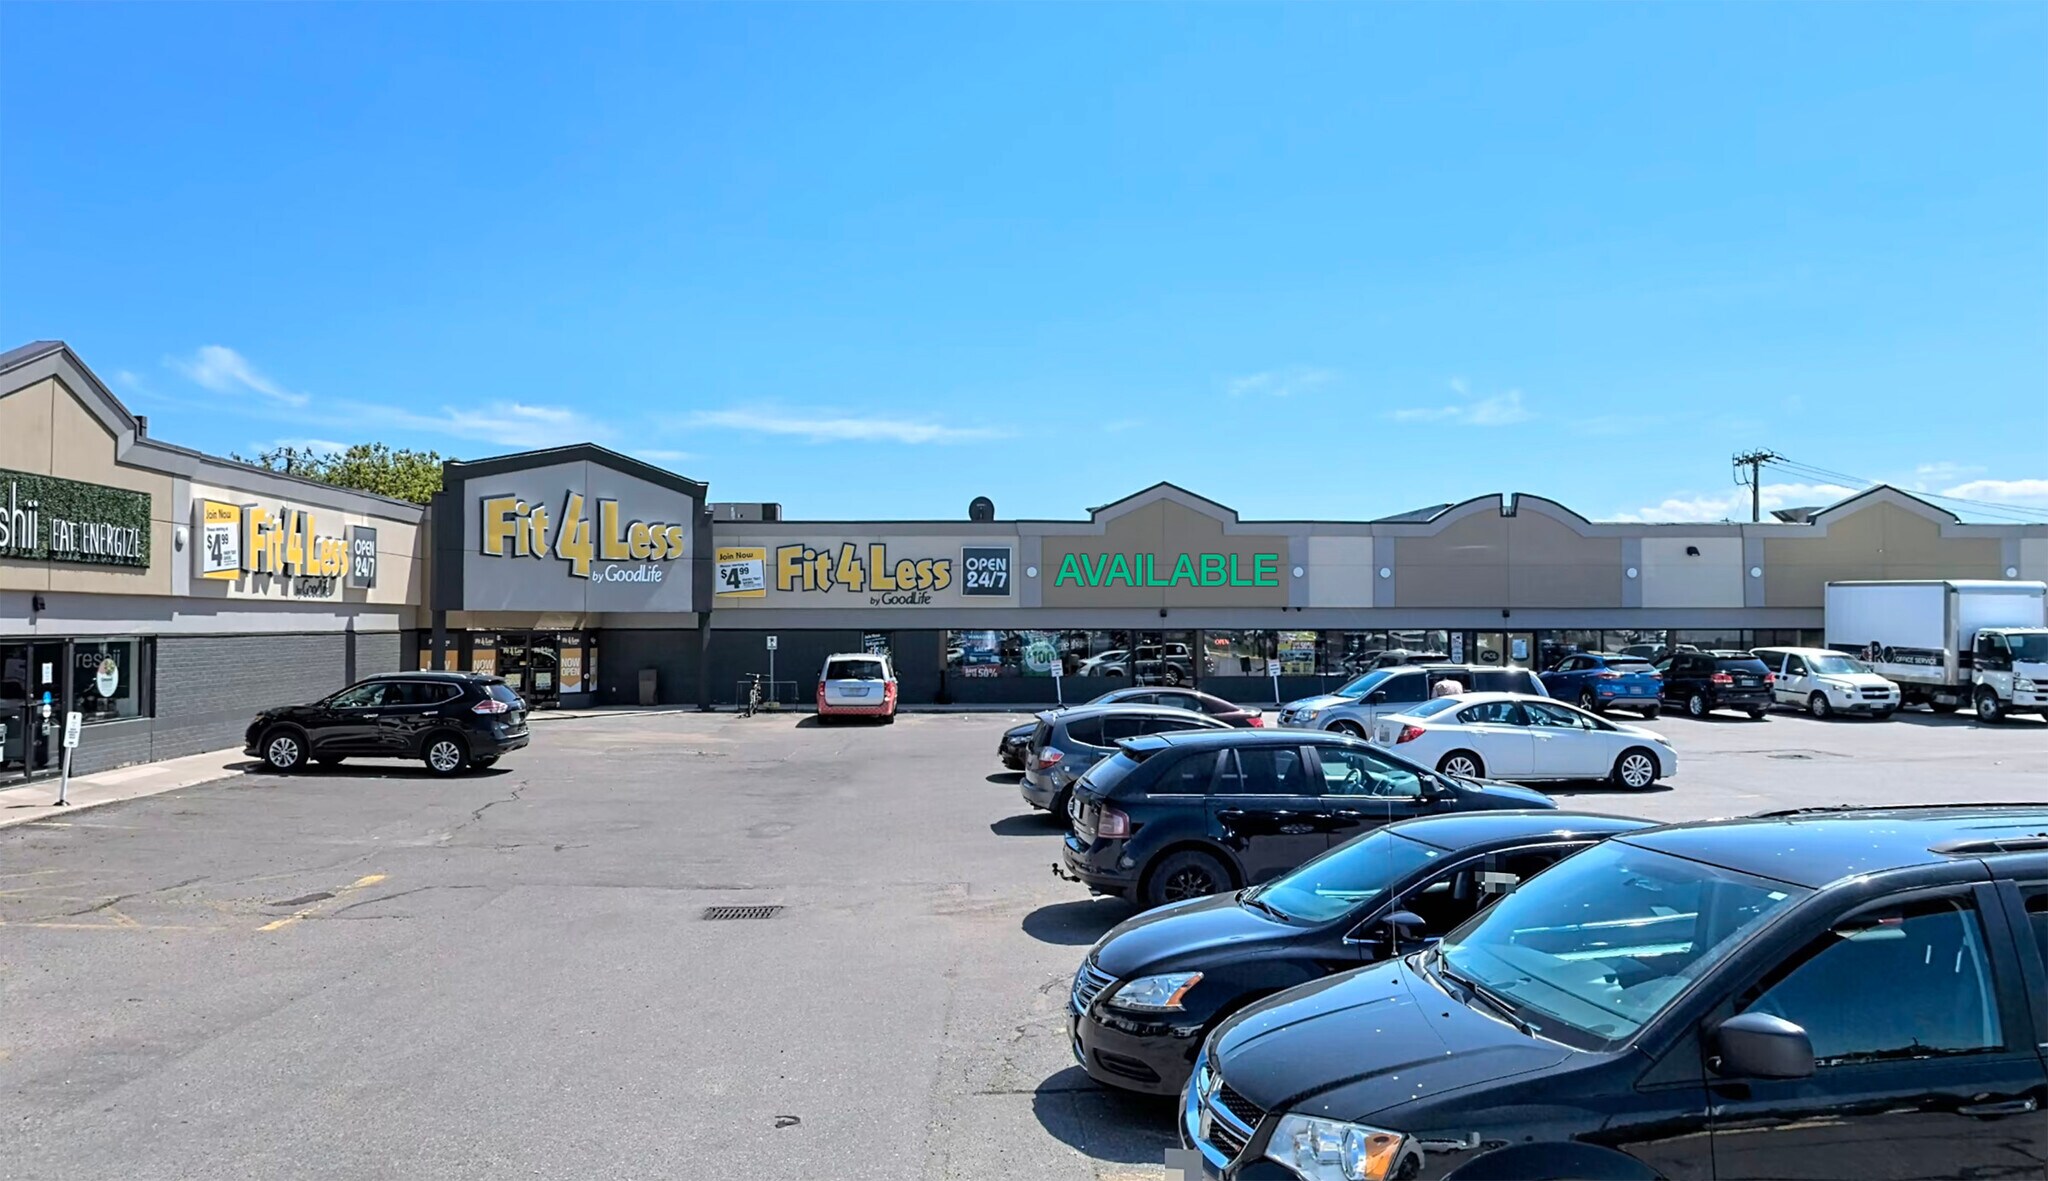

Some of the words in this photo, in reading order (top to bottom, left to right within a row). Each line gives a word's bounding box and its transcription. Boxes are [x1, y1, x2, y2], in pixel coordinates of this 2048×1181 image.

[206, 509, 217, 519] Join
[218, 509, 232, 519] Now
[480, 496, 550, 559] Fit
[555, 491, 594, 577] 4
[599, 499, 684, 560] Less
[354, 539, 375, 557] OPEN
[719, 553, 734, 561] Join
[735, 551, 754, 559] Now
[355, 557, 375, 577] 24/7
[776, 543, 834, 593] Fit
[835, 542, 866, 593] 4
[868, 543, 952, 592] Less
[965, 557, 1007, 571] OPEN
[592, 570, 605, 583] by
[605, 564, 663, 583] GoodLife
[966, 571, 1008, 588] 24/7
[870, 596, 881, 606] by
[881, 591, 932, 605] GoodLife
[473, 659, 495, 669] NOW
[561, 657, 581, 667] NOW
[1914, 657, 1937, 666] SERVICE
[561, 667, 580, 676] OPEN
